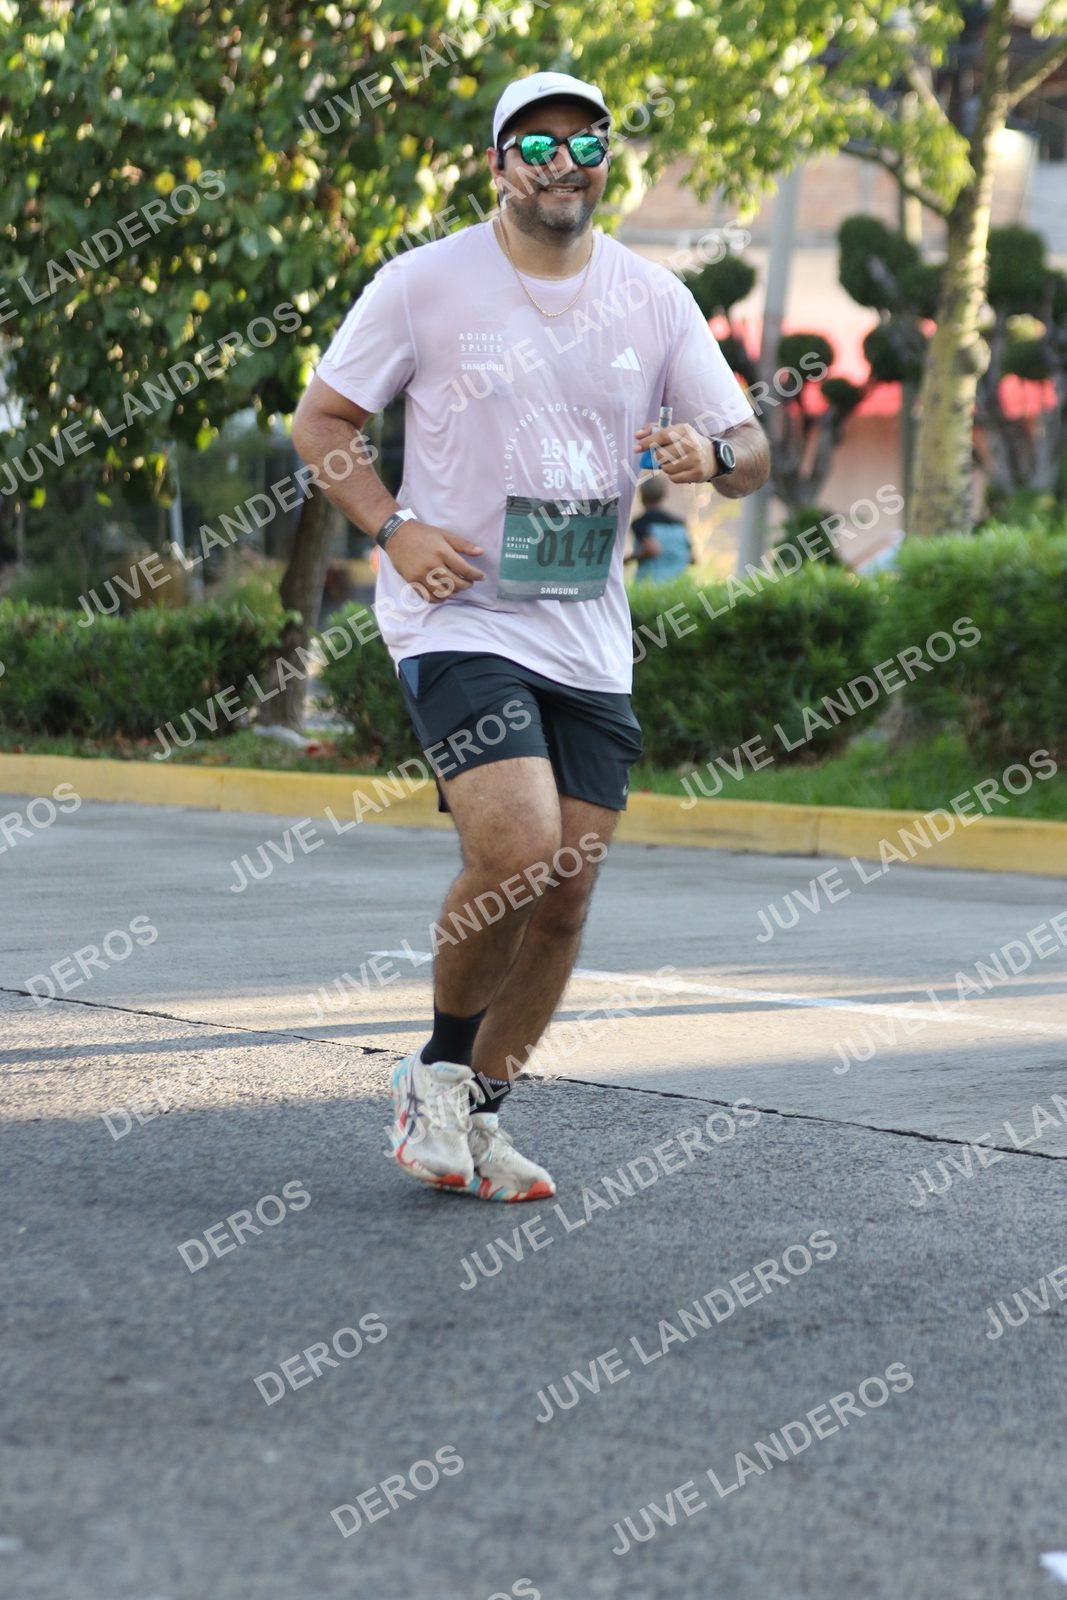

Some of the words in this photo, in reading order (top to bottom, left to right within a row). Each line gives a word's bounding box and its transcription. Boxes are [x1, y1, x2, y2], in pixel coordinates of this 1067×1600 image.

[458, 332, 504, 342] ADIDAS
[460, 344, 502, 353] SPLITS
[540, 437, 564, 459] 15
[542, 468, 566, 489] 30
[536, 528, 614, 567] 0147
[540, 587, 579, 595] SAMSUNG
